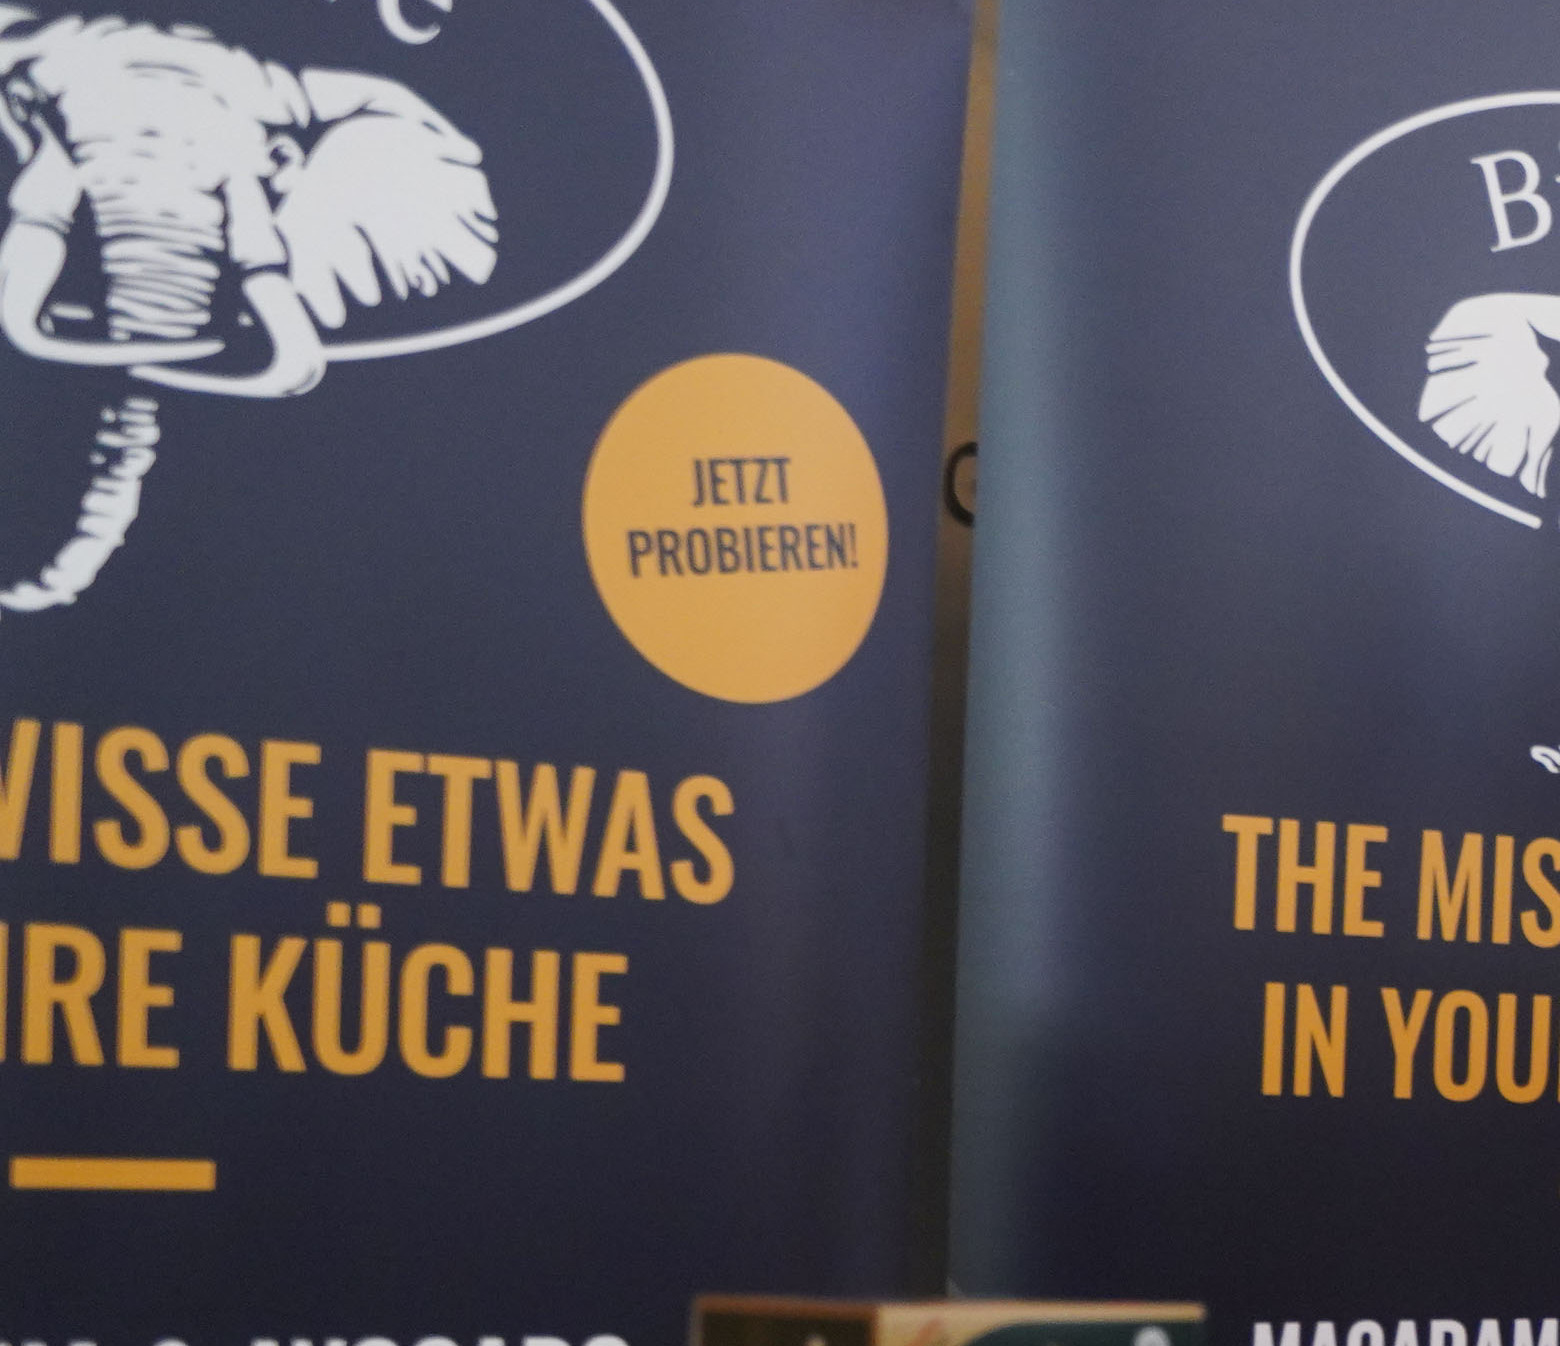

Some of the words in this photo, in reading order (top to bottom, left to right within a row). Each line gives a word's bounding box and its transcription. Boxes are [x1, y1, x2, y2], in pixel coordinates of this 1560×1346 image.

[691, 457, 792, 508] JETZT
[627, 522, 860, 578] PROBIEREN!
[362, 750, 736, 904] ETWAS
[1222, 814, 1388, 938] THE
[0, 923, 182, 1068] RE
[226, 903, 628, 1082] KÜCHE
[1261, 981, 1348, 1098] IN
